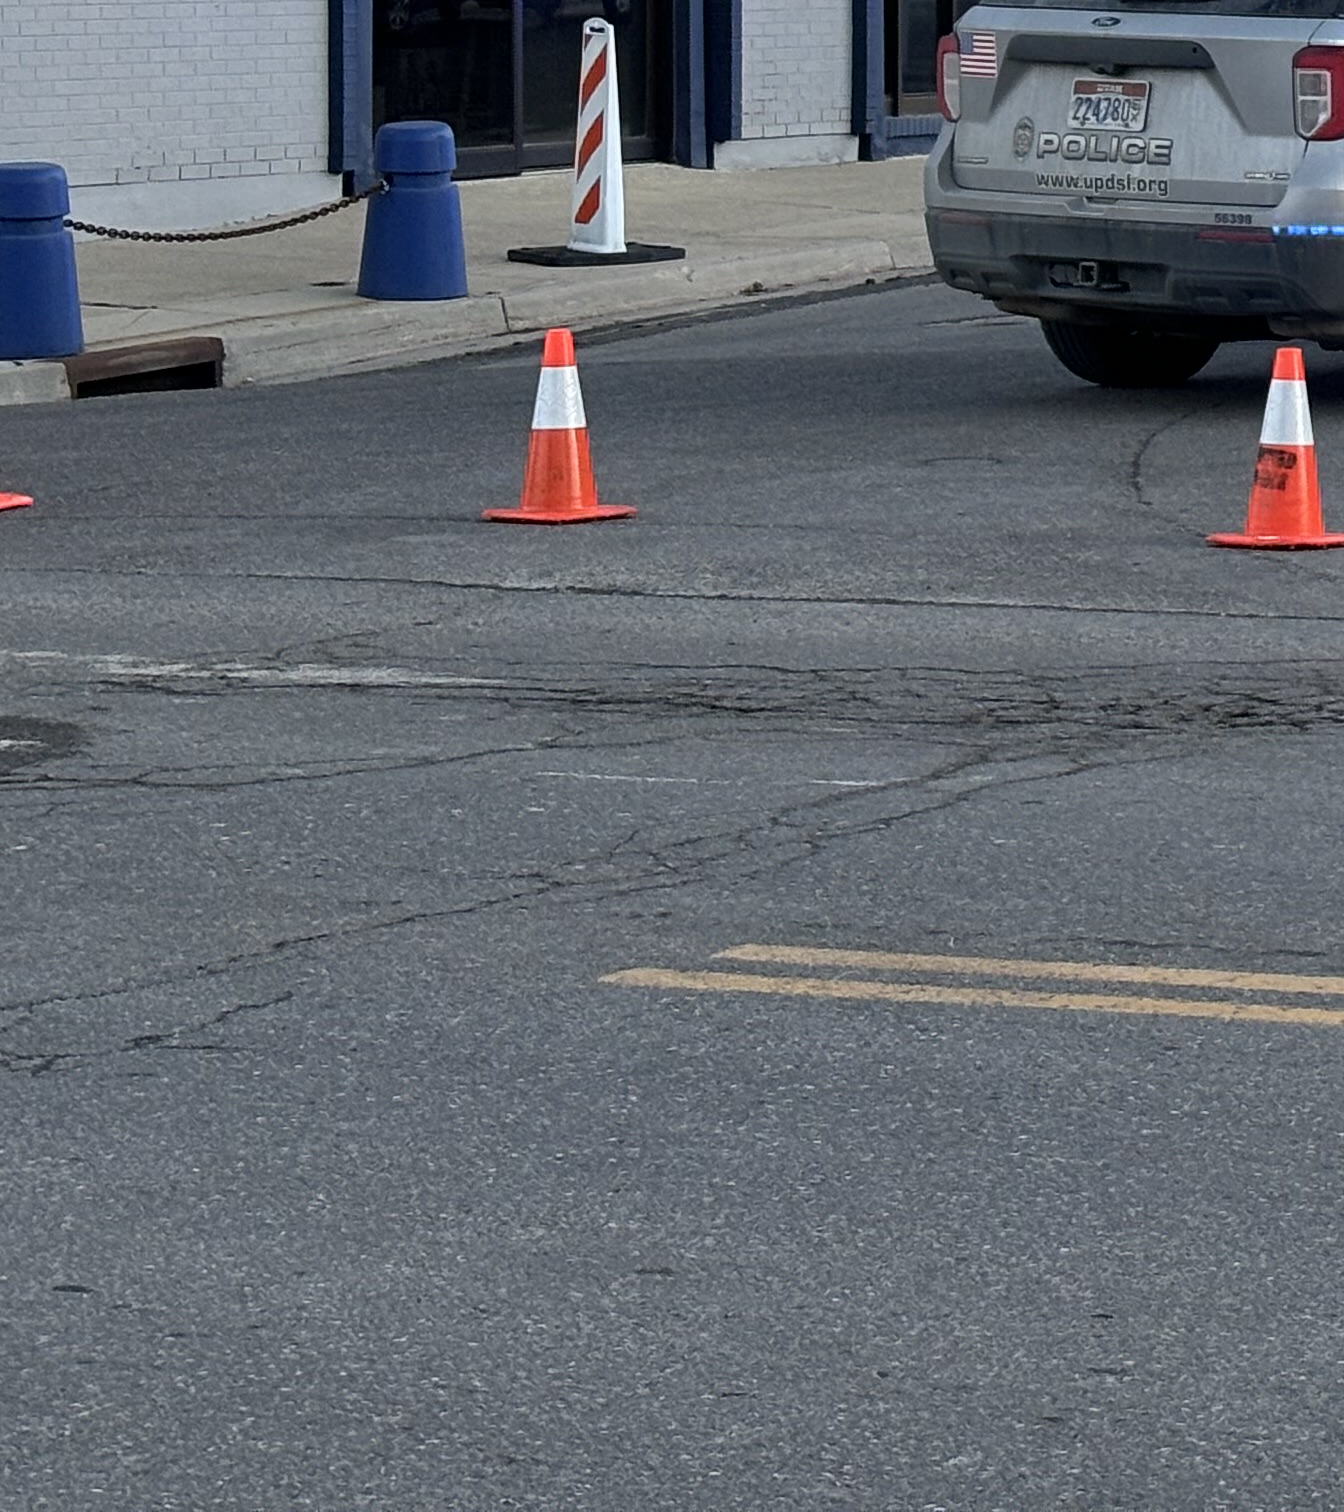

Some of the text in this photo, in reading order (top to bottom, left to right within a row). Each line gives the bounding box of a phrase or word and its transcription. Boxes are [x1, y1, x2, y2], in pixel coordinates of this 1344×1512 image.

[1072, 96, 1132, 123] 224780
[1037, 131, 1174, 166] POLICE
[1035, 173, 1169, 197] www.updsl.org
[1214, 212, 1253, 225] 56398
